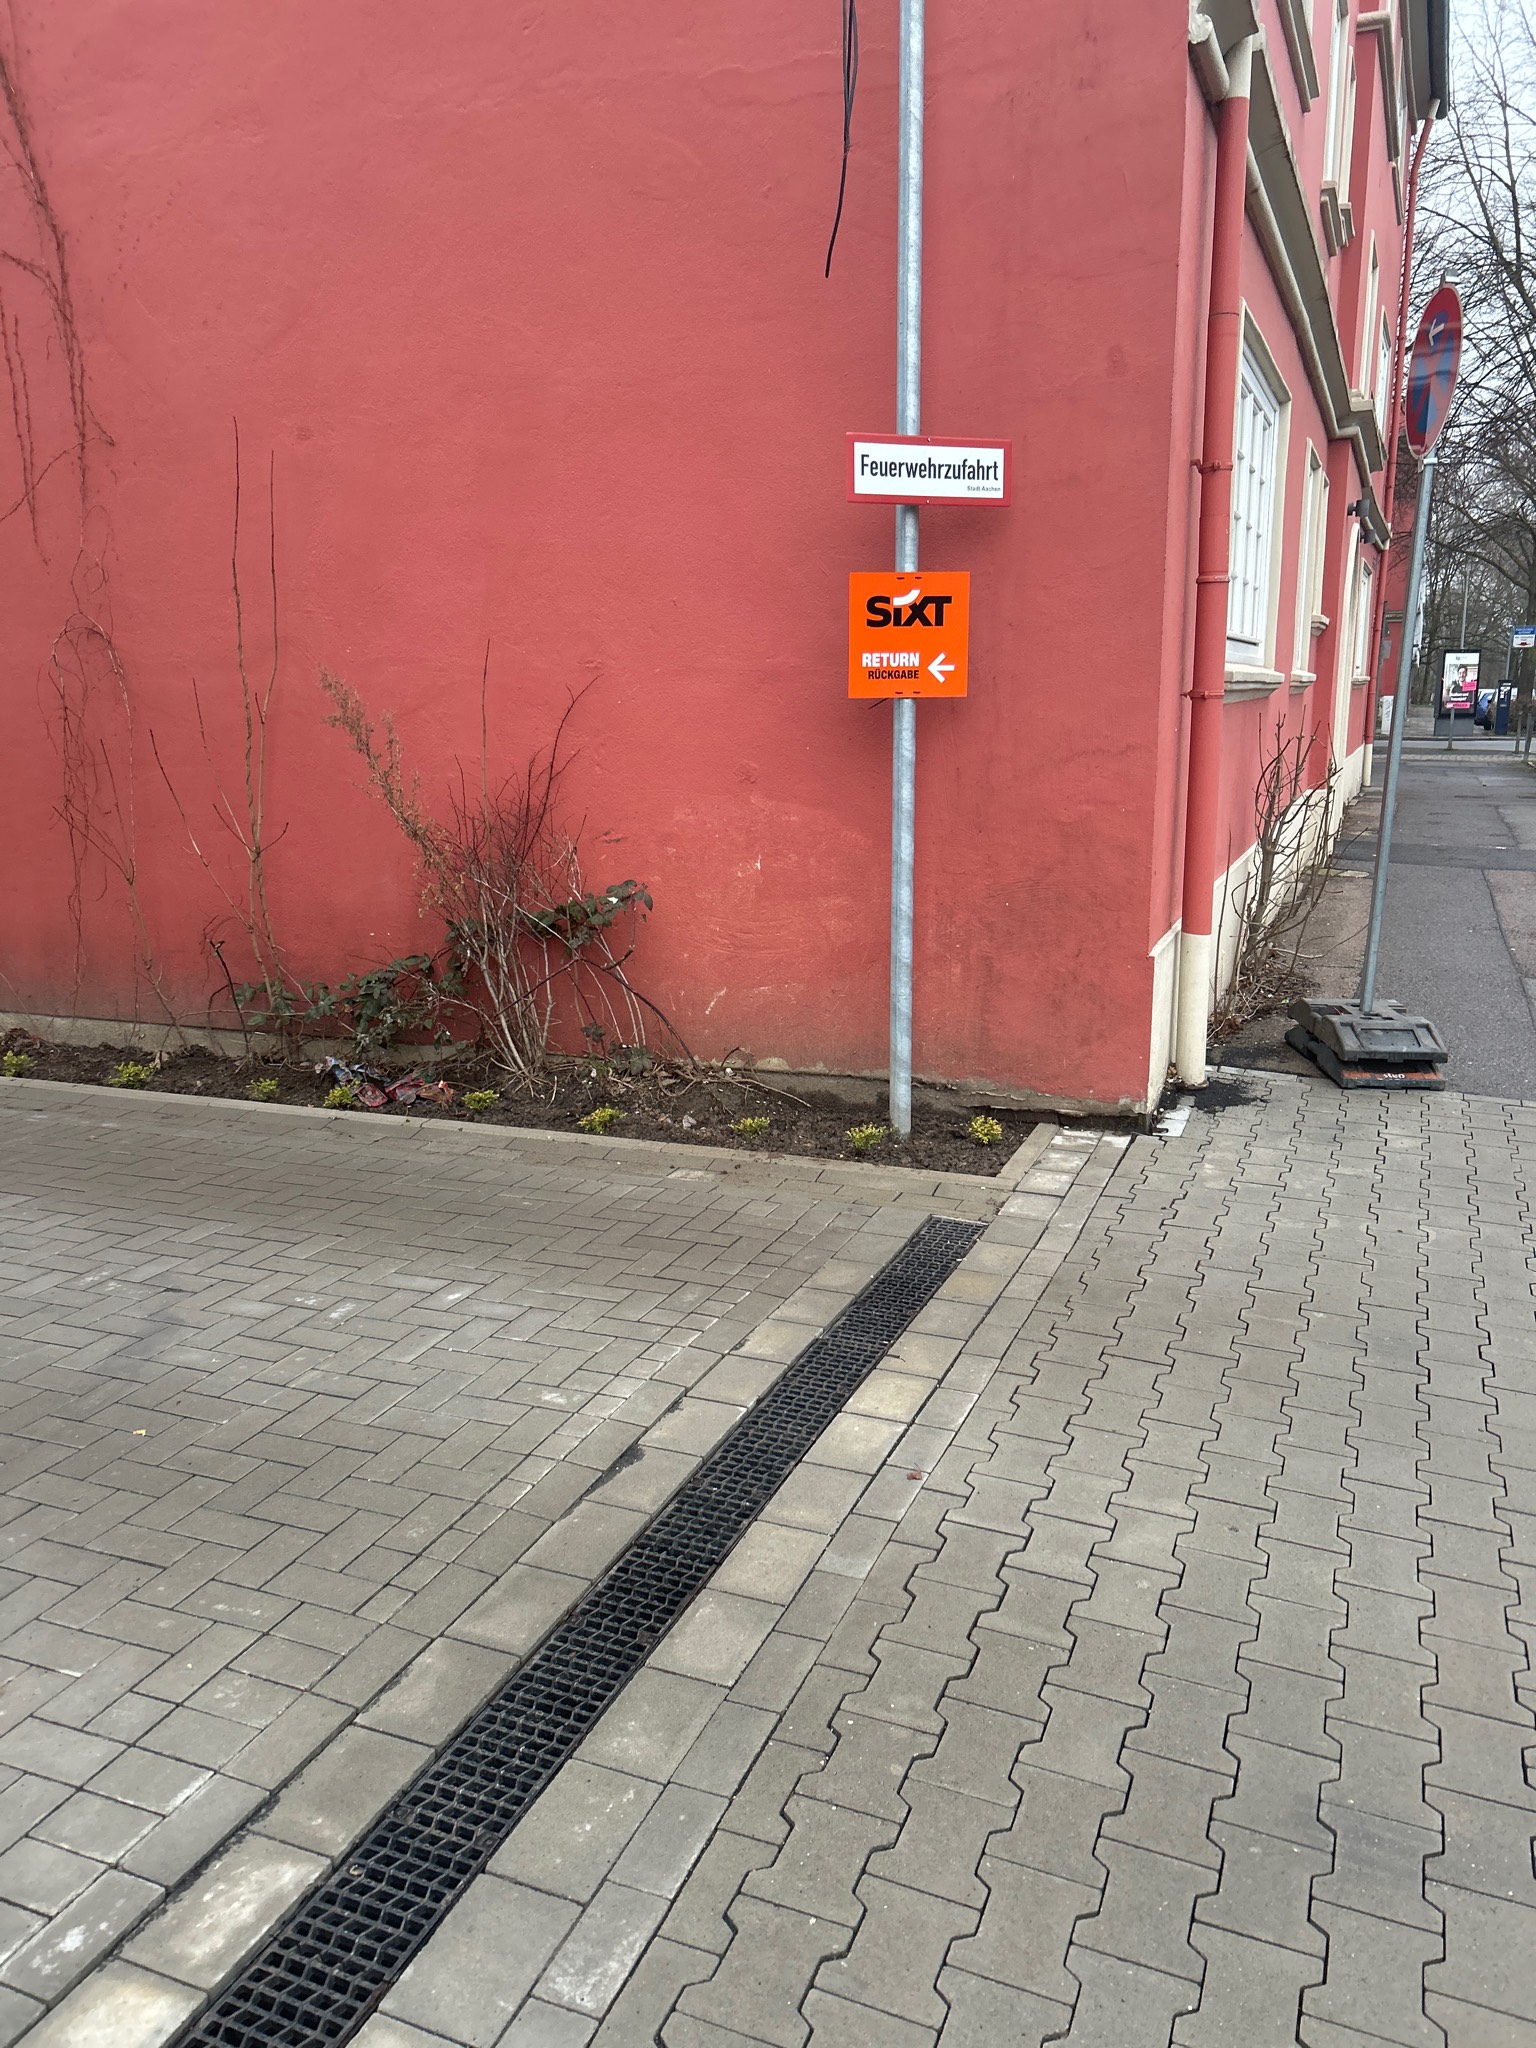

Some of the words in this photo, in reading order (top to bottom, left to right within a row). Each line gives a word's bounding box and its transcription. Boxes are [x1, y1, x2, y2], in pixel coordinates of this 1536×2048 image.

[860, 453, 999, 481] Feuerwehrzufahrt
[861, 652, 920, 668] RETURN
[867, 668, 920, 680] RÜCKGABE
